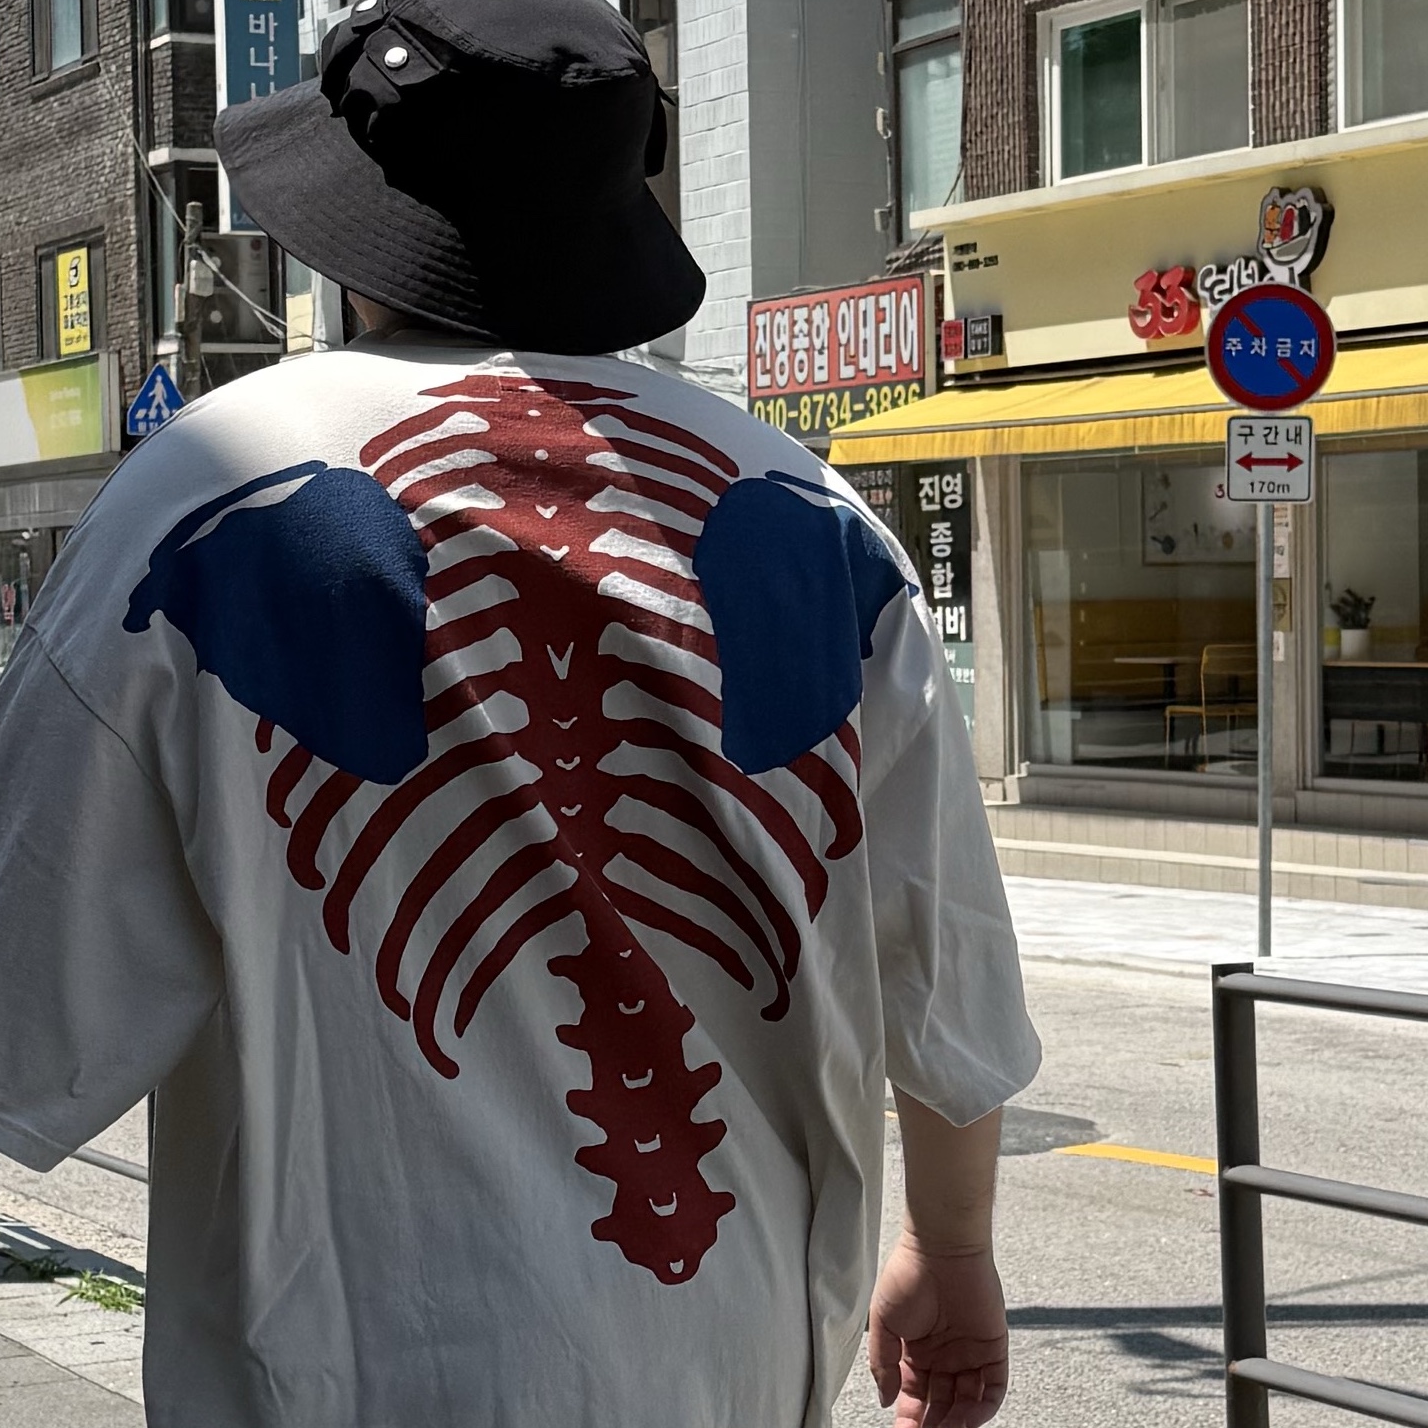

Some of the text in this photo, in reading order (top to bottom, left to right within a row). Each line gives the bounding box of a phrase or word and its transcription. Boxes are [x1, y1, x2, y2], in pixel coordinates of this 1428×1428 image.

[754, 287, 919, 388] 진영종합 인테리어
[1128, 265, 1196, 340] 33
[918, 473, 963, 511] 진영
[1249, 481, 1290, 494] 170m
[929, 522, 955, 599] 종합
